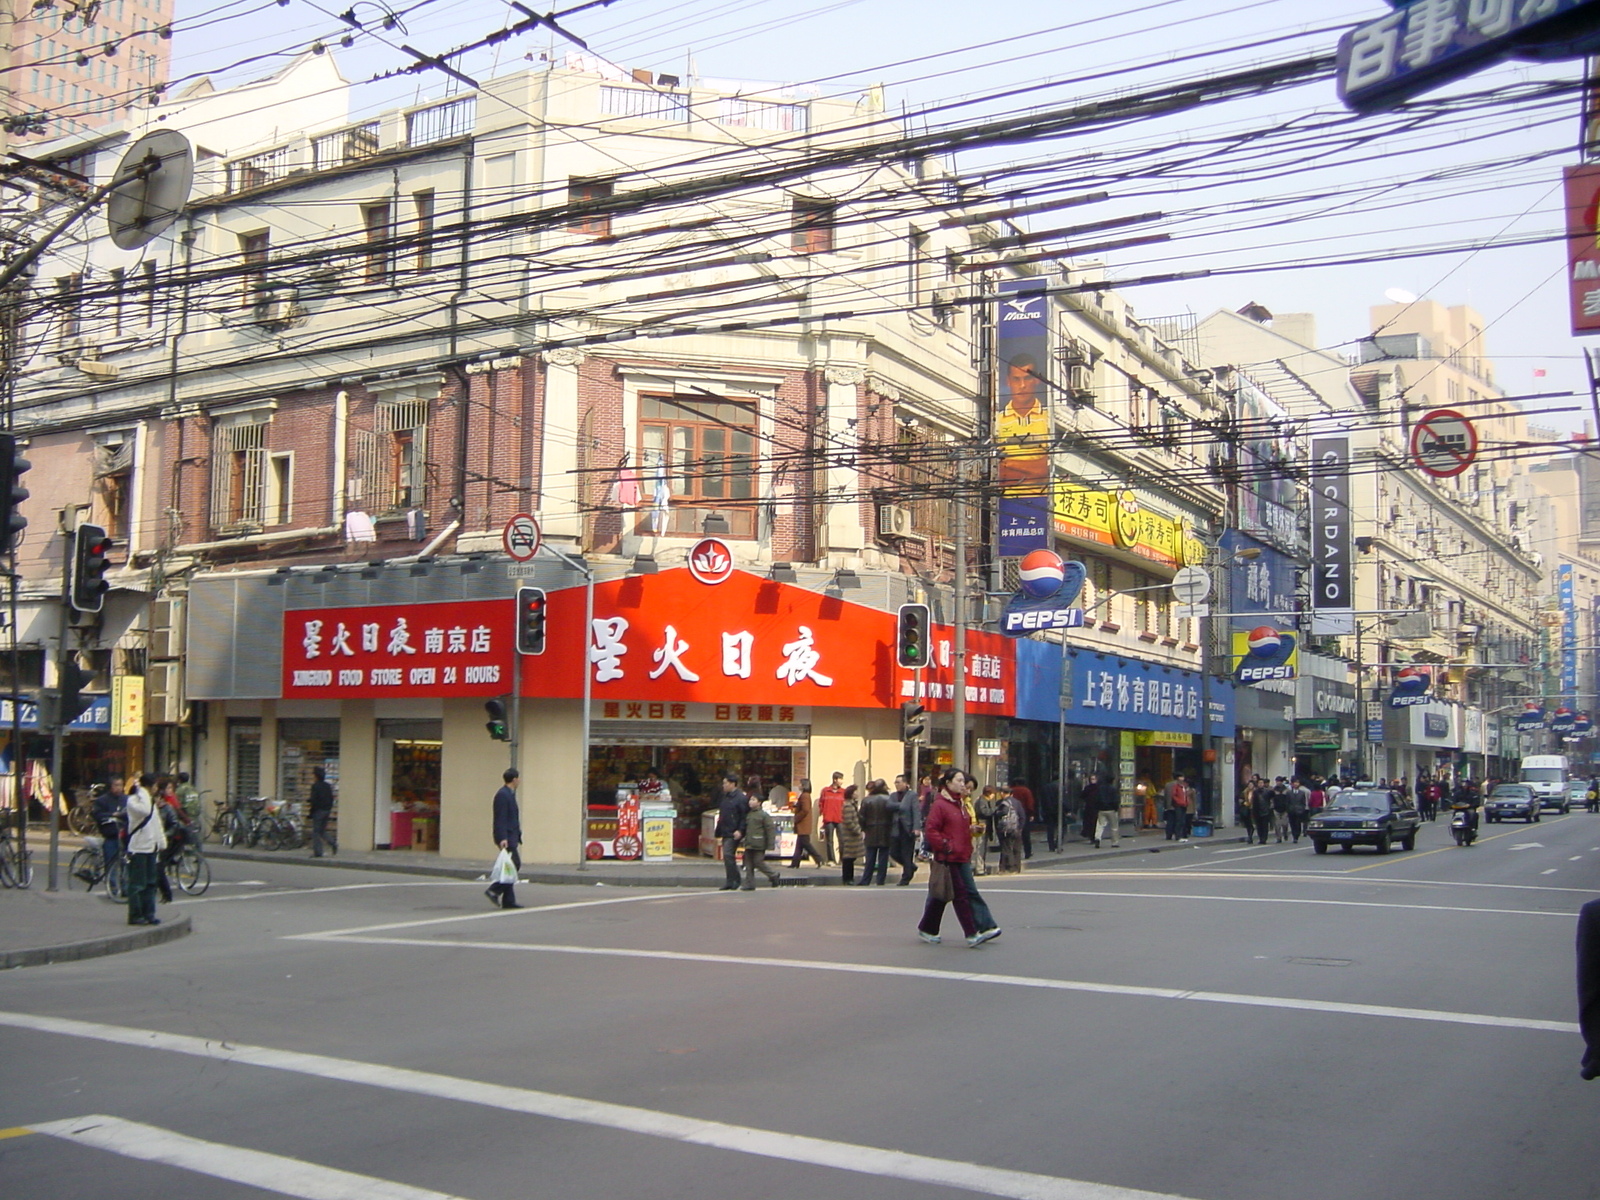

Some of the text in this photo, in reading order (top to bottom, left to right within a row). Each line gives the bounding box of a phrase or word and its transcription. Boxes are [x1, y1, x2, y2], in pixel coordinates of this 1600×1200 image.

[1574, 261, 1600, 280] M
[1006, 608, 1077, 631] PEPSI
[303, 617, 491, 659] 星火日夜 南京店
[589, 616, 833, 687] 星火日夜
[339, 669, 363, 686] FOOD
[370, 668, 403, 686] STORE
[410, 667, 436, 685] OPEN
[443, 667, 456, 684] 24
[465, 665, 500, 683] HOURS
[1240, 666, 1291, 680] PEPSI
[1082, 670, 1197, 720] 上海体育用品总店
[1392, 696, 1428, 706] PEPSI
[604, 702, 795, 722] 星火日夜 日夜服务
[1517, 722, 1545, 730] PEPSI
